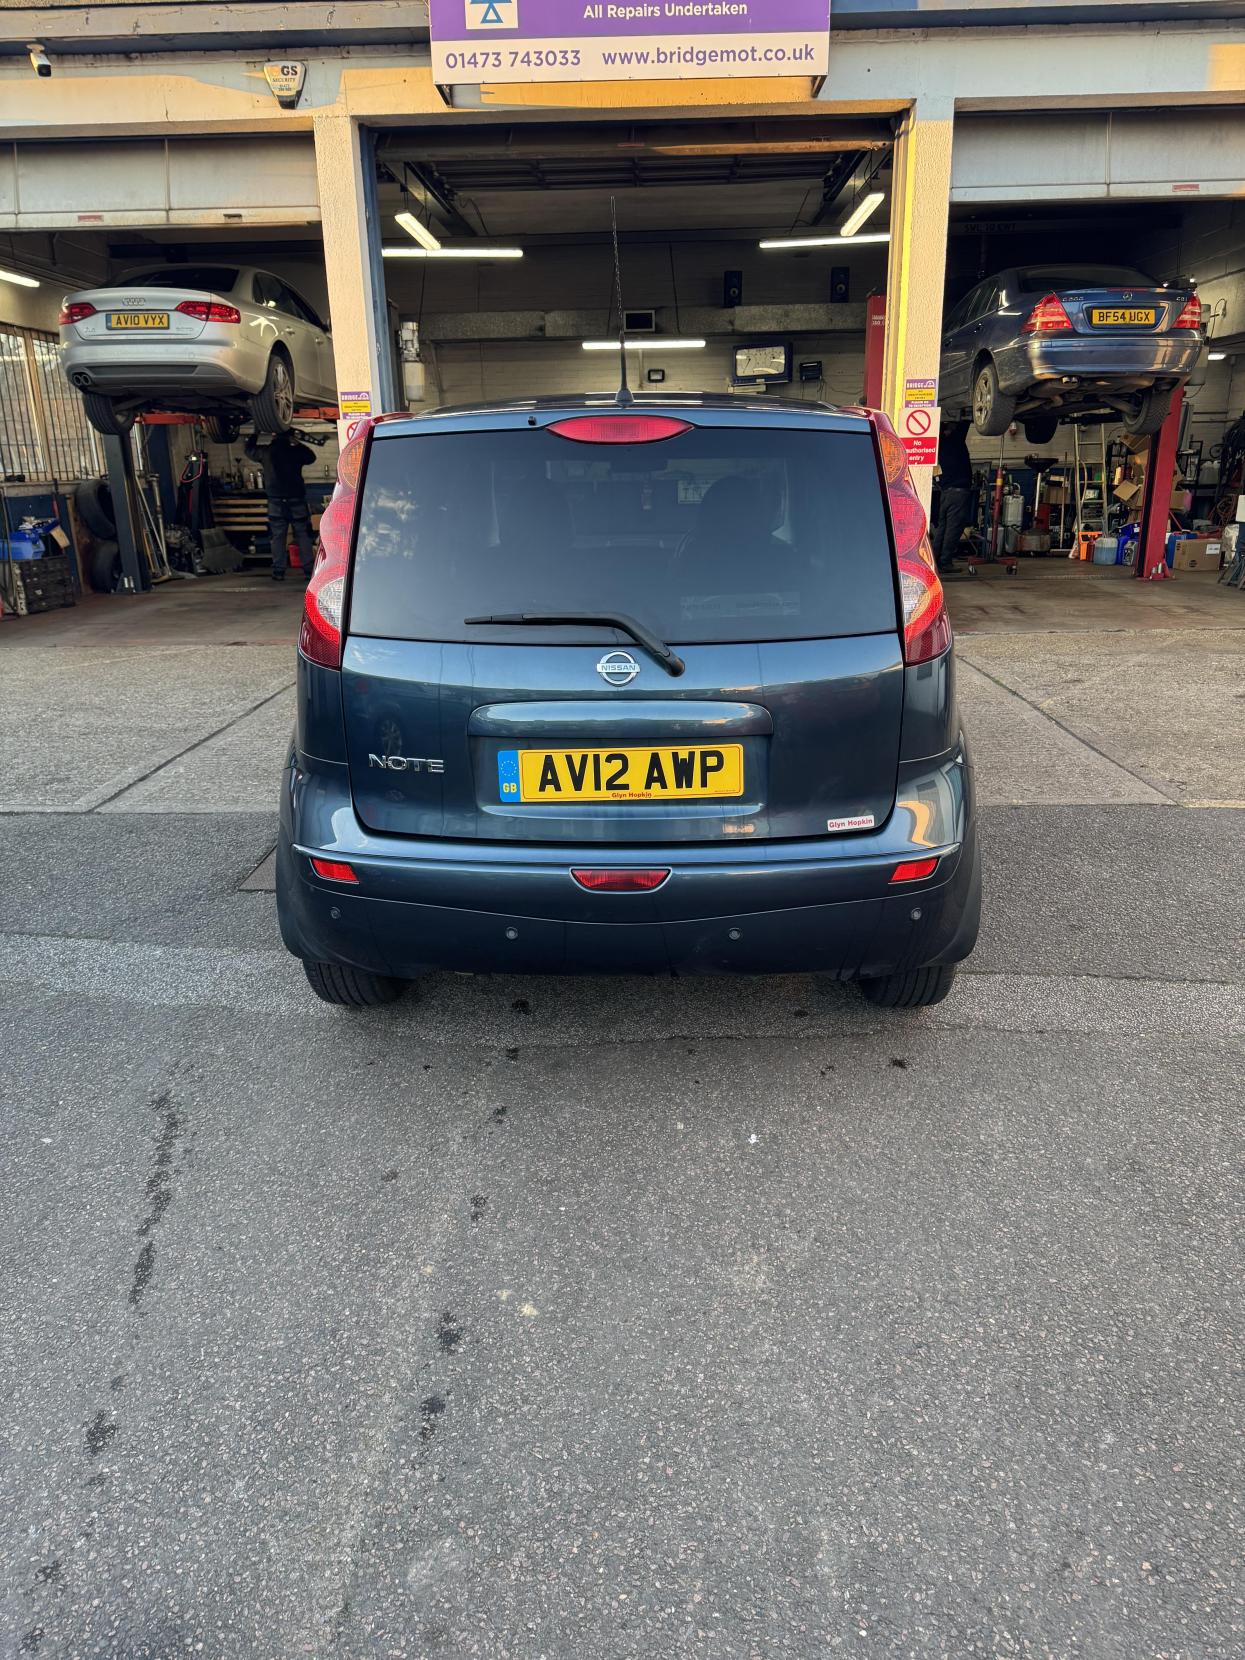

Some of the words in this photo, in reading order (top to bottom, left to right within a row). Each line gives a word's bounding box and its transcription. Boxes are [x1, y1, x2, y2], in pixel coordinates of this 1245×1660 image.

[584, 5, 603, 18] All
[607, 3, 660, 20] Repairs
[664, 2, 748, 17] Undertaken
[445, 52, 502, 69] 01473
[508, 50, 581, 67] 743033
[602, 44, 815, 66] www.bridgemot.co.uk
[281, 65, 298, 76] GS
[116, 315, 140, 326] AV10
[143, 314, 164, 326] VYX
[1097, 311, 1127, 322] BF54
[1129, 311, 1150, 322] UGX
[368, 753, 445, 773] NOTE
[538, 753, 630, 792] AV12
[644, 750, 725, 790] AWP
[502, 782, 517, 793] GB
